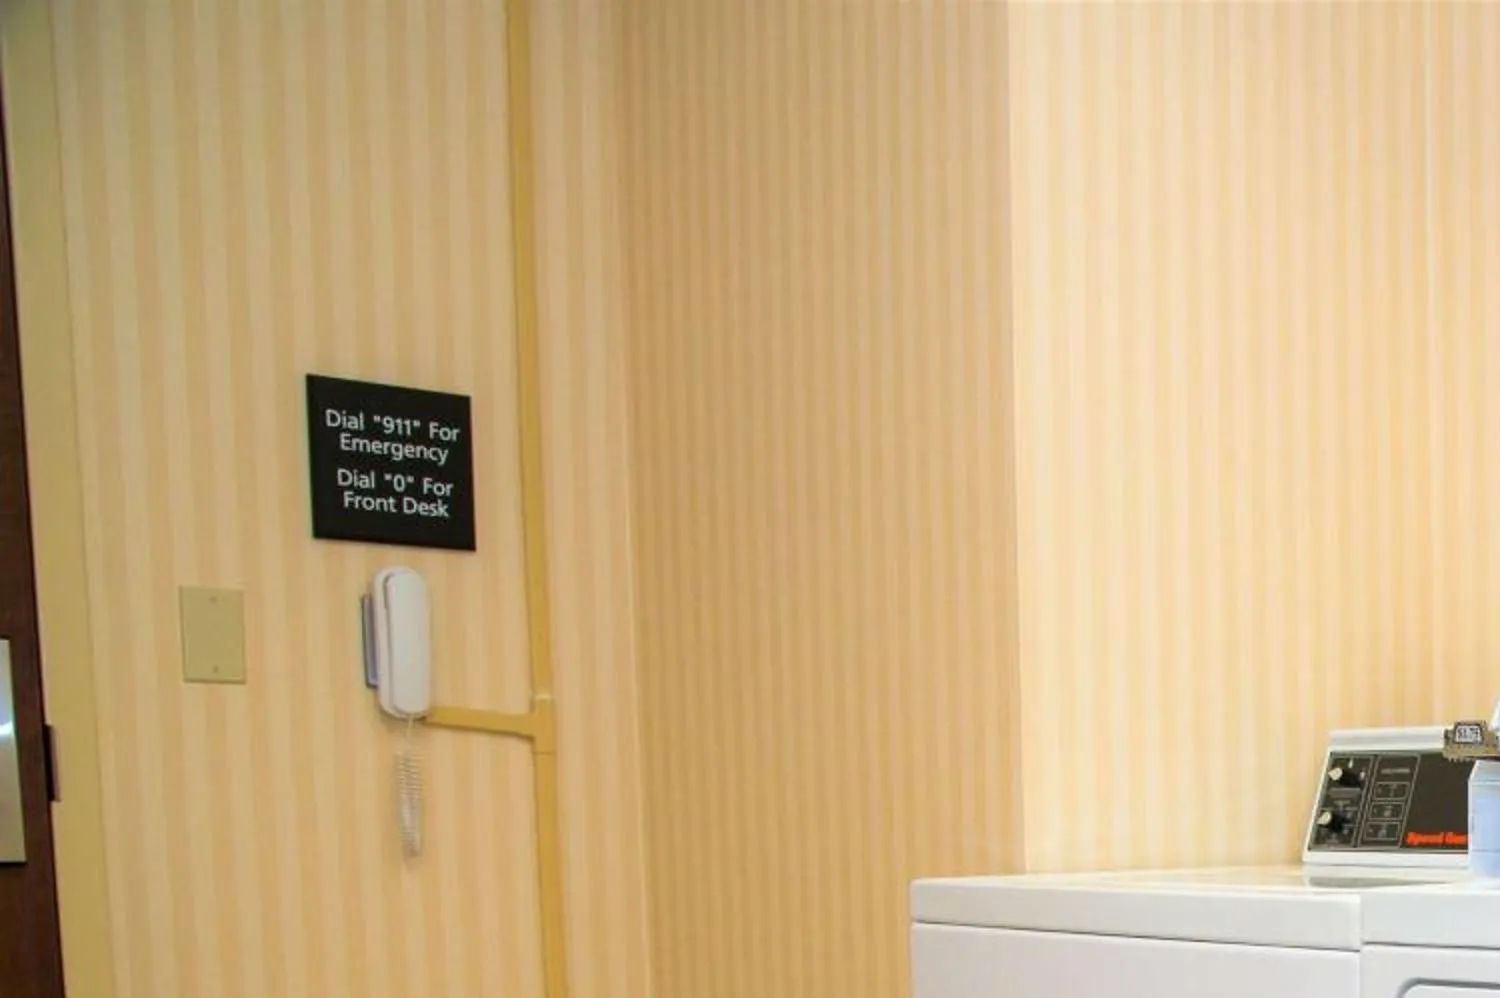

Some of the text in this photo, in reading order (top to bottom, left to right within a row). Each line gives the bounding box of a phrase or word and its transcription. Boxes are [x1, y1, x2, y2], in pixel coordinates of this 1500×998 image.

[325, 409, 460, 442] Dial "911" For
[340, 433, 449, 466] Emergency
[337, 468, 376, 489] Dial
[422, 478, 454, 496] For
[343, 491, 449, 517] Front Desk
